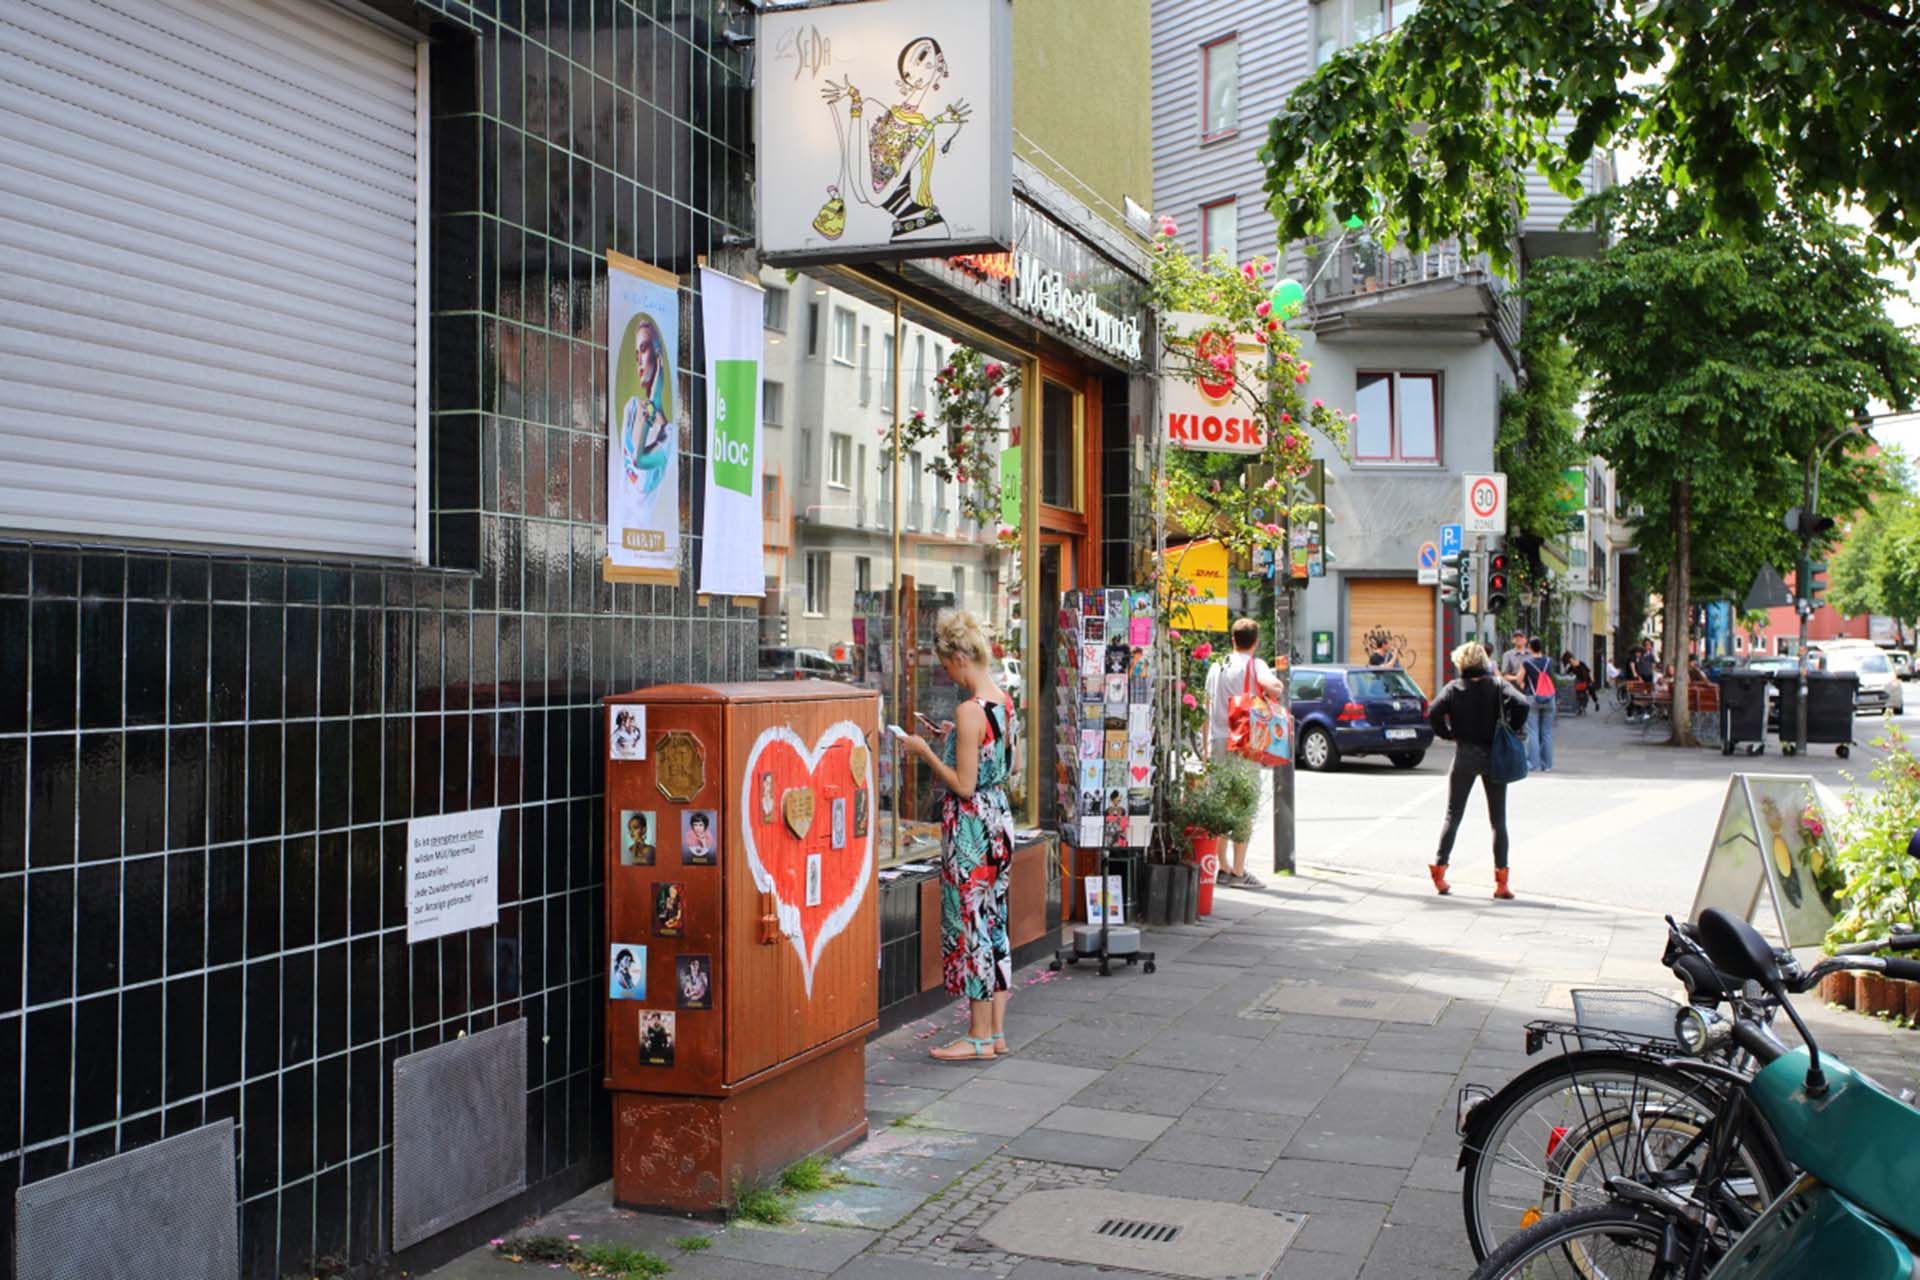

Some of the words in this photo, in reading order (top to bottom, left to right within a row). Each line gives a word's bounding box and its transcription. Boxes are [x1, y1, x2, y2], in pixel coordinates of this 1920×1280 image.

[1168, 413, 1262, 445] KIOSK
[1477, 488, 1493, 506] 30
[1444, 528, 1454, 546] P
